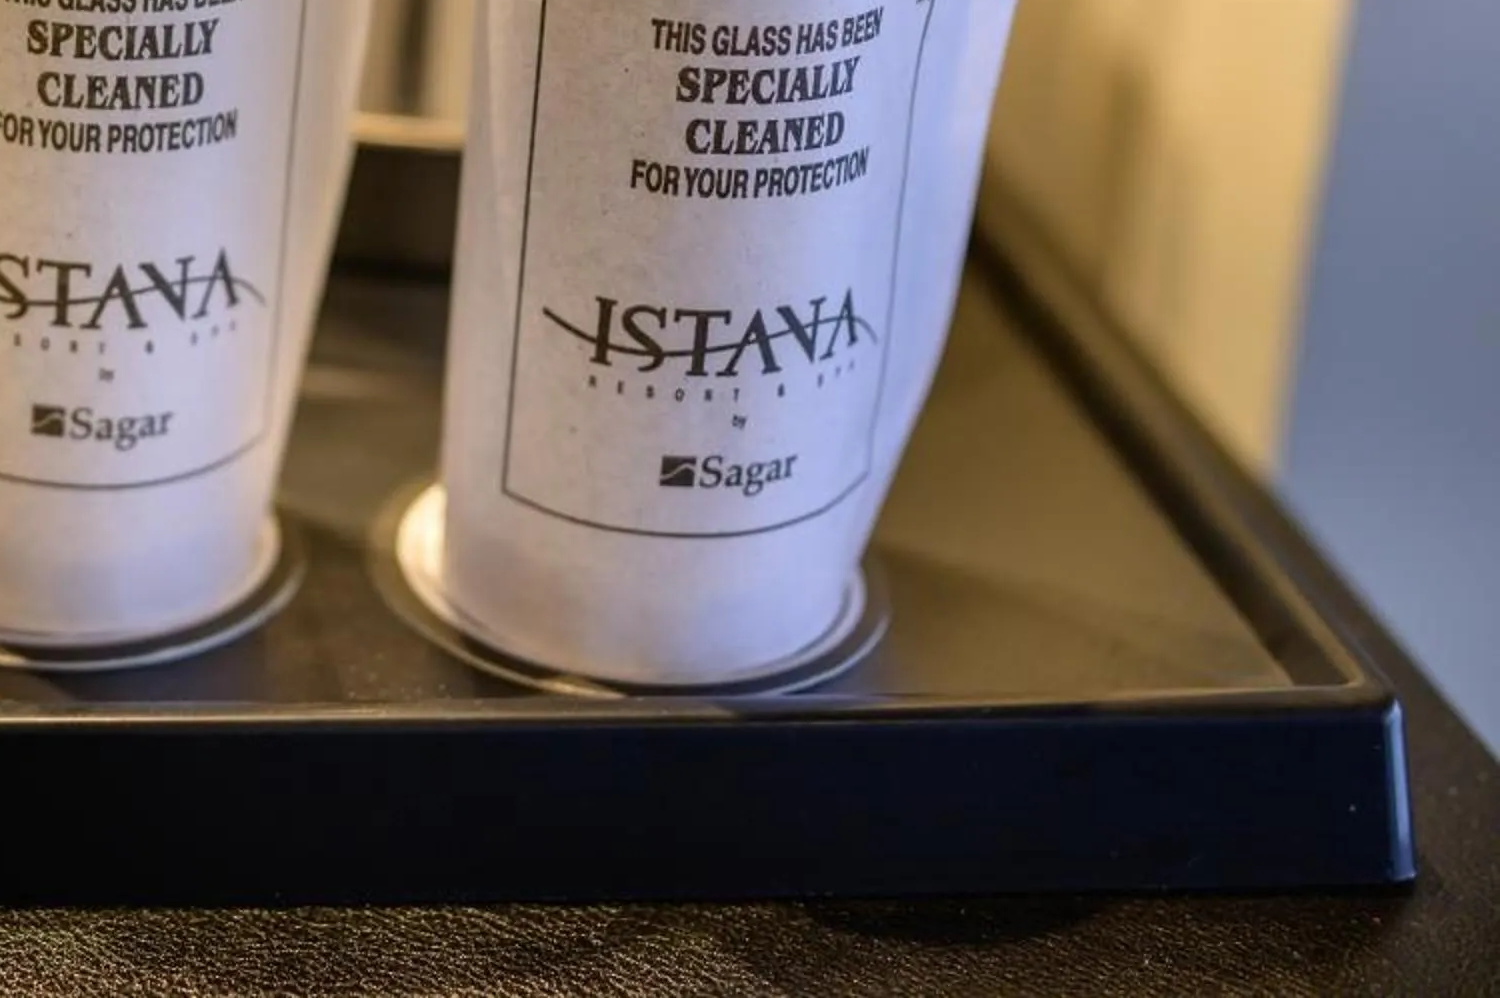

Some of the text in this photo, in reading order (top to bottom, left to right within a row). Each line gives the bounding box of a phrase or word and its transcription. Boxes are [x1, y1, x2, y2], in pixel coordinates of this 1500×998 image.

[26, 19, 220, 61] SPECIALLY
[651, 6, 884, 57] THIS GLASS HAS BEEN
[36, 71, 205, 110] CLEANED
[675, 55, 861, 105] SPECIALLY
[39, 119, 101, 153] YOUR
[107, 108, 239, 154] PROTECTION
[685, 110, 846, 156] CLEANED
[630, 145, 870, 200] FOR YOUR PROTECTION
[67, 405, 176, 452] Sagar
[698, 454, 799, 498] Sagar
